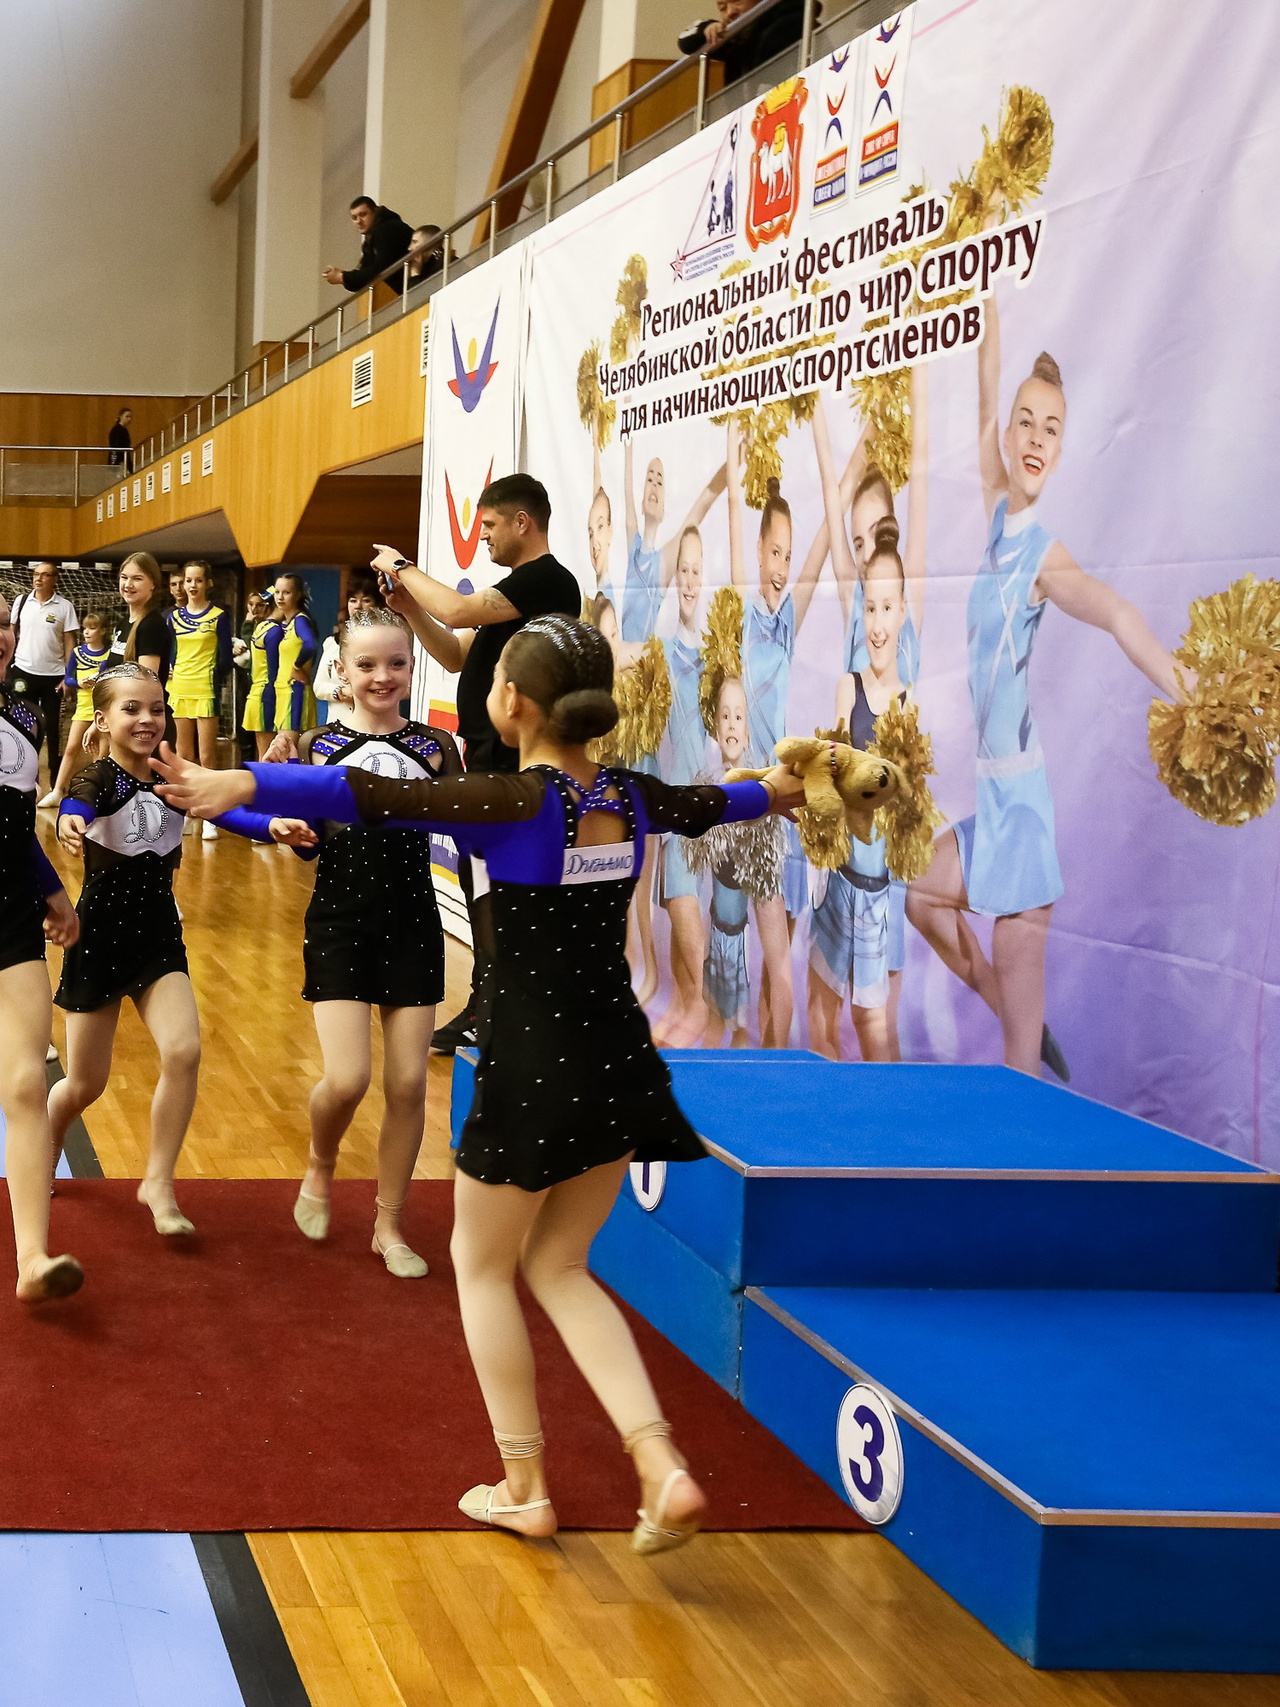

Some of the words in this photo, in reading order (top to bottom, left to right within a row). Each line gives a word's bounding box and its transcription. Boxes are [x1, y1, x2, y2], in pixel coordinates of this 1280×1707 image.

[599, 326, 718, 397] Челябинской
[722, 302, 812, 360] области
[819, 289, 851, 330] по
[859, 266, 913, 319] чир
[920, 219, 1042, 294] спорту
[642, 248, 789, 341] Региональный
[795, 198, 944, 295] фестиваль
[620, 404, 647, 442] для
[651, 363, 788, 426] начинающих
[791, 305, 981, 391] спортсменов
[849, 1405, 885, 1503] 3
